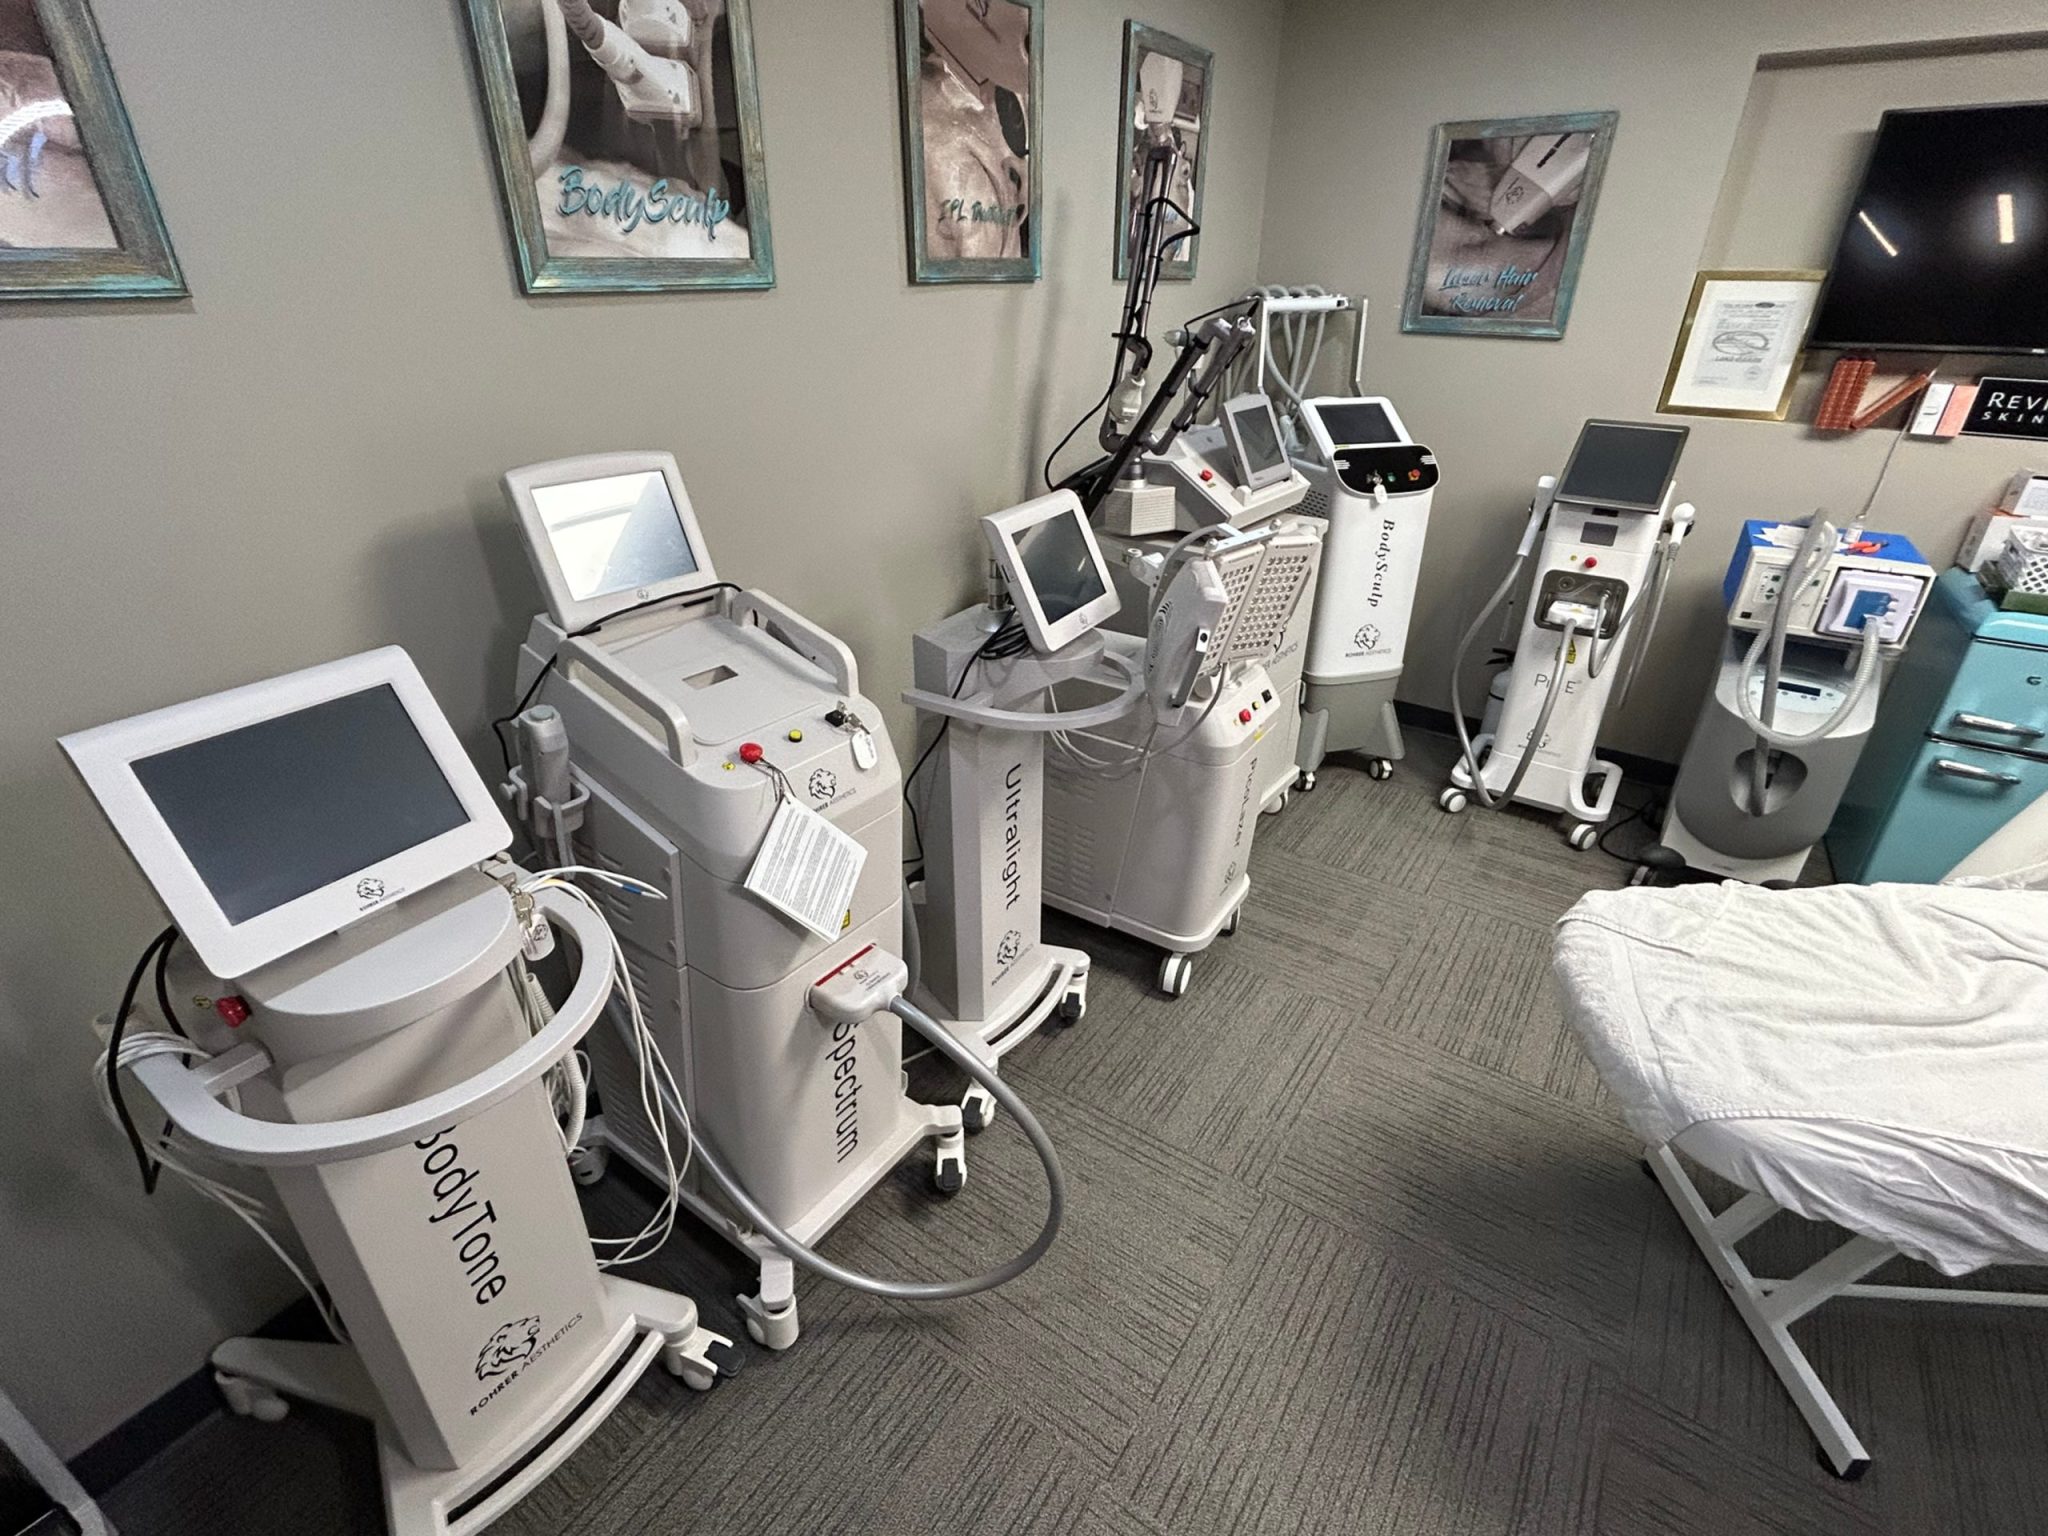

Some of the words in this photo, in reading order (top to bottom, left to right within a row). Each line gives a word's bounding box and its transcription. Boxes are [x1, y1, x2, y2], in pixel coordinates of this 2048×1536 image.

[557, 165, 730, 241] BodySculp
[1449, 291, 1525, 313] Removal
[1981, 411, 2045, 424] SKIN
[1367, 519, 1395, 608] BodySculp
[1002, 763, 1022, 911] Ultralight
[470, 1369, 519, 1416] ROHRER
[521, 1312, 583, 1372] AESTHETICS
